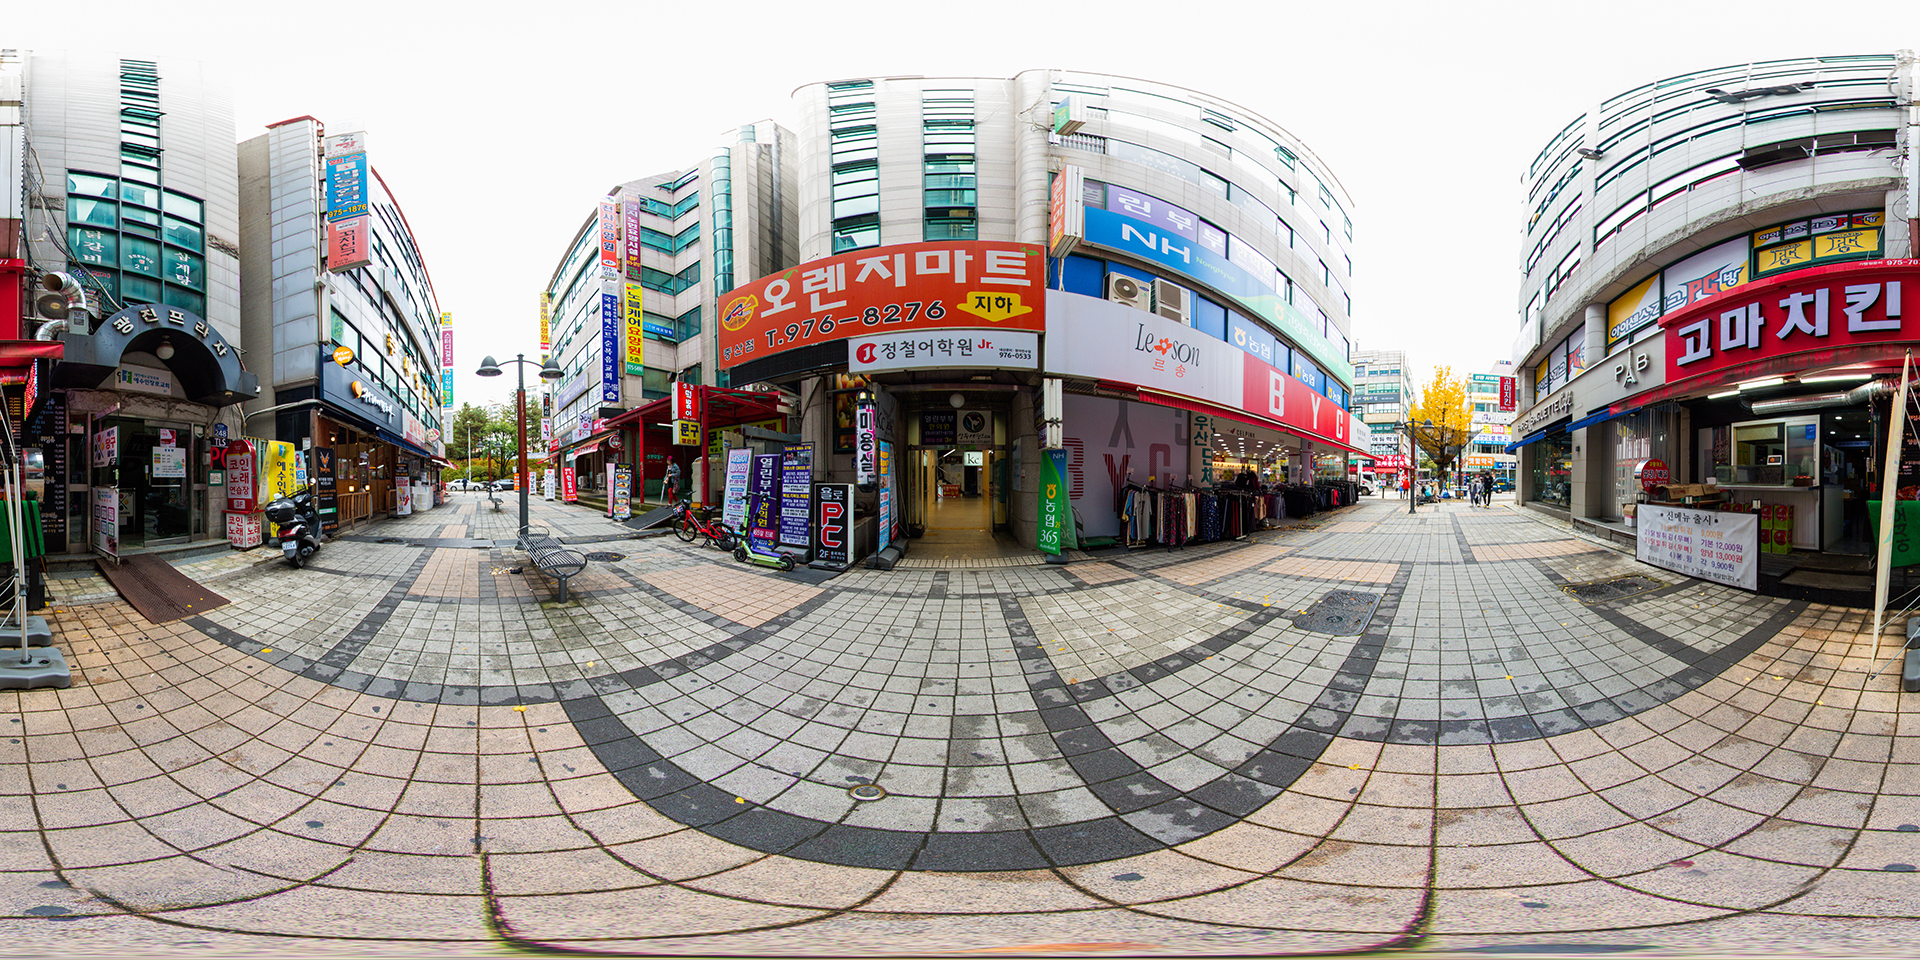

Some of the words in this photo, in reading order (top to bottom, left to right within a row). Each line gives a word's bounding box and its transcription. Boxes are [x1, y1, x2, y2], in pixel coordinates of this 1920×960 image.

[328, 203, 368, 218] 975-1876
[1122, 223, 1190, 265] NH
[1195, 256, 1237, 284] NongHyup
[1886, 258, 1920, 266] 975-70
[761, 249, 1031, 319] 오렌지마트
[974, 295, 1013, 314] 지하
[628, 291, 641, 357] 노블케어요양원
[765, 300, 946, 348] T.976-8276
[1676, 280, 1902, 367] 고마치킨
[113, 308, 228, 357] 광진프라자
[723, 338, 754, 361] 중산점
[881, 337, 973, 361] 정철어학원
[977, 338, 994, 350] Jr.
[1248, 335, 1271, 360] 농협
[998, 352, 1032, 360] 976-0533
[1152, 358, 1187, 379] 르송
[133, 377, 170, 389] 예수인장로교회
[1302, 368, 1316, 388] 농협
[1332, 389, 1342, 405] 농협
[1503, 377, 1512, 406] 고마치킨
[1268, 369, 1344, 440] BYC
[924, 415, 954, 423] 열린부부
[214, 430, 228, 438] 248
[681, 423, 699, 438] 문구
[105, 437, 116, 450] 당구
[214, 438, 226, 446] TLS
[860, 412, 873, 473] 미용실
[229, 458, 249, 471] 코인
[967, 453, 980, 465] kc
[229, 472, 249, 484] 노래
[1642, 468, 1669, 479] 포장/배달
[229, 486, 249, 495] 연습장
[228, 516, 243, 526] 코인
[247, 515, 260, 525] 코인
[757, 502, 770, 528] 한의원
[1045, 499, 1056, 528] 농협
[1666, 511, 1690, 523] 신메뉴
[1693, 514, 1712, 526] 출시
[228, 526, 243, 536] 노래
[247, 525, 260, 536] 노래
[821, 501, 845, 549] PC
[765, 530, 774, 538] 진료
[1040, 529, 1058, 544] 365
[1700, 529, 1724, 540] 9,000원
[1701, 539, 1714, 549] 기본
[1715, 542, 1743, 553] 12,000원
[820, 549, 829, 559] 2F
[1700, 548, 1714, 558] 양념
[1715, 552, 1743, 564] 13,000원
[1701, 558, 1707, 567] 각
[1711, 560, 1735, 573] 9,900원
